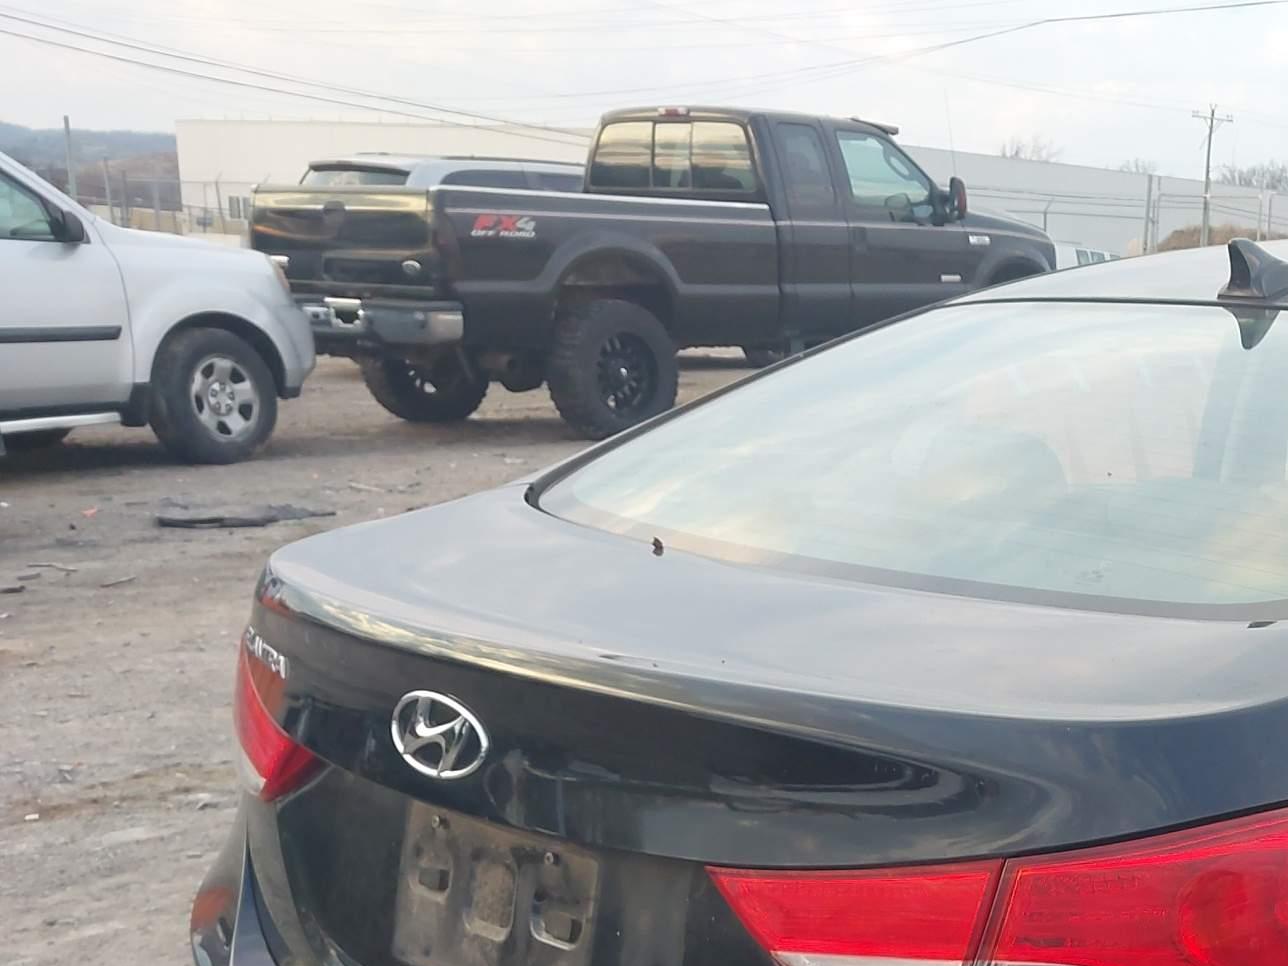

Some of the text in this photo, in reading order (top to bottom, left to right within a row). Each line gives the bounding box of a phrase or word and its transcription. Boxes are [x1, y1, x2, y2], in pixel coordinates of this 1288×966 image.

[472, 213, 536, 232] FX4
[470, 229, 537, 238] OFF ROAD
